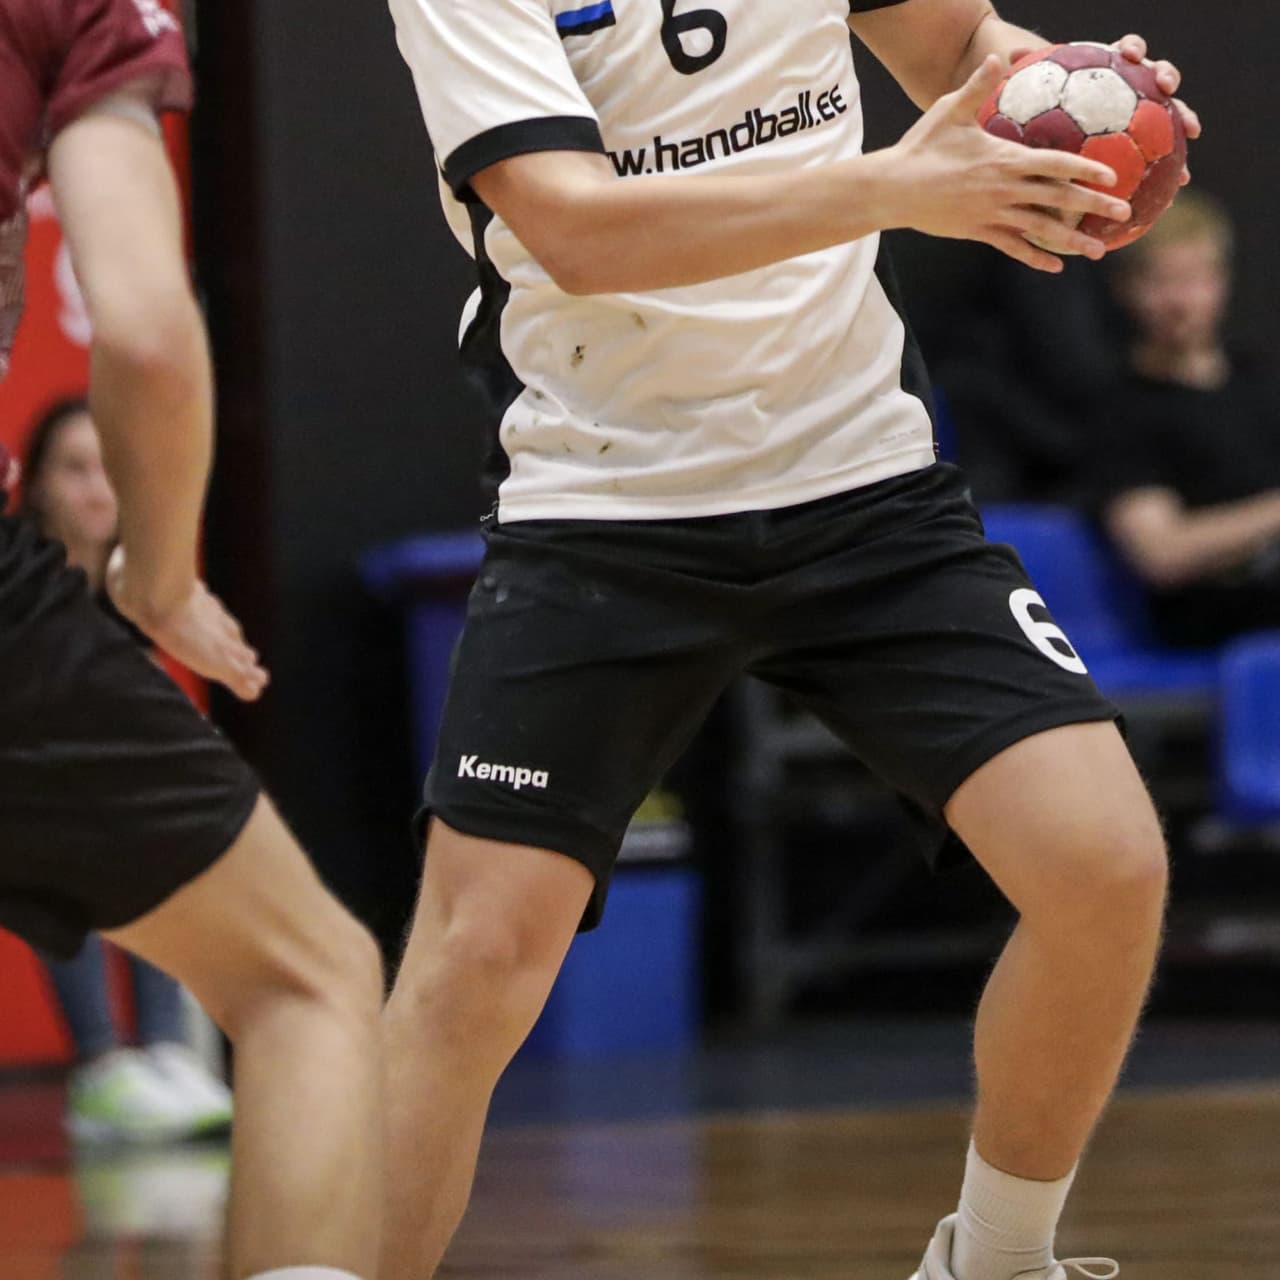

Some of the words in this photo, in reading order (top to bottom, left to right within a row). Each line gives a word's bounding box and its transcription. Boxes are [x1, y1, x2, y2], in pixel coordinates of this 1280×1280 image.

[608, 84, 848, 177] w.handball.ee
[1009, 587, 1088, 674] 6
[457, 754, 549, 790] Kempa
